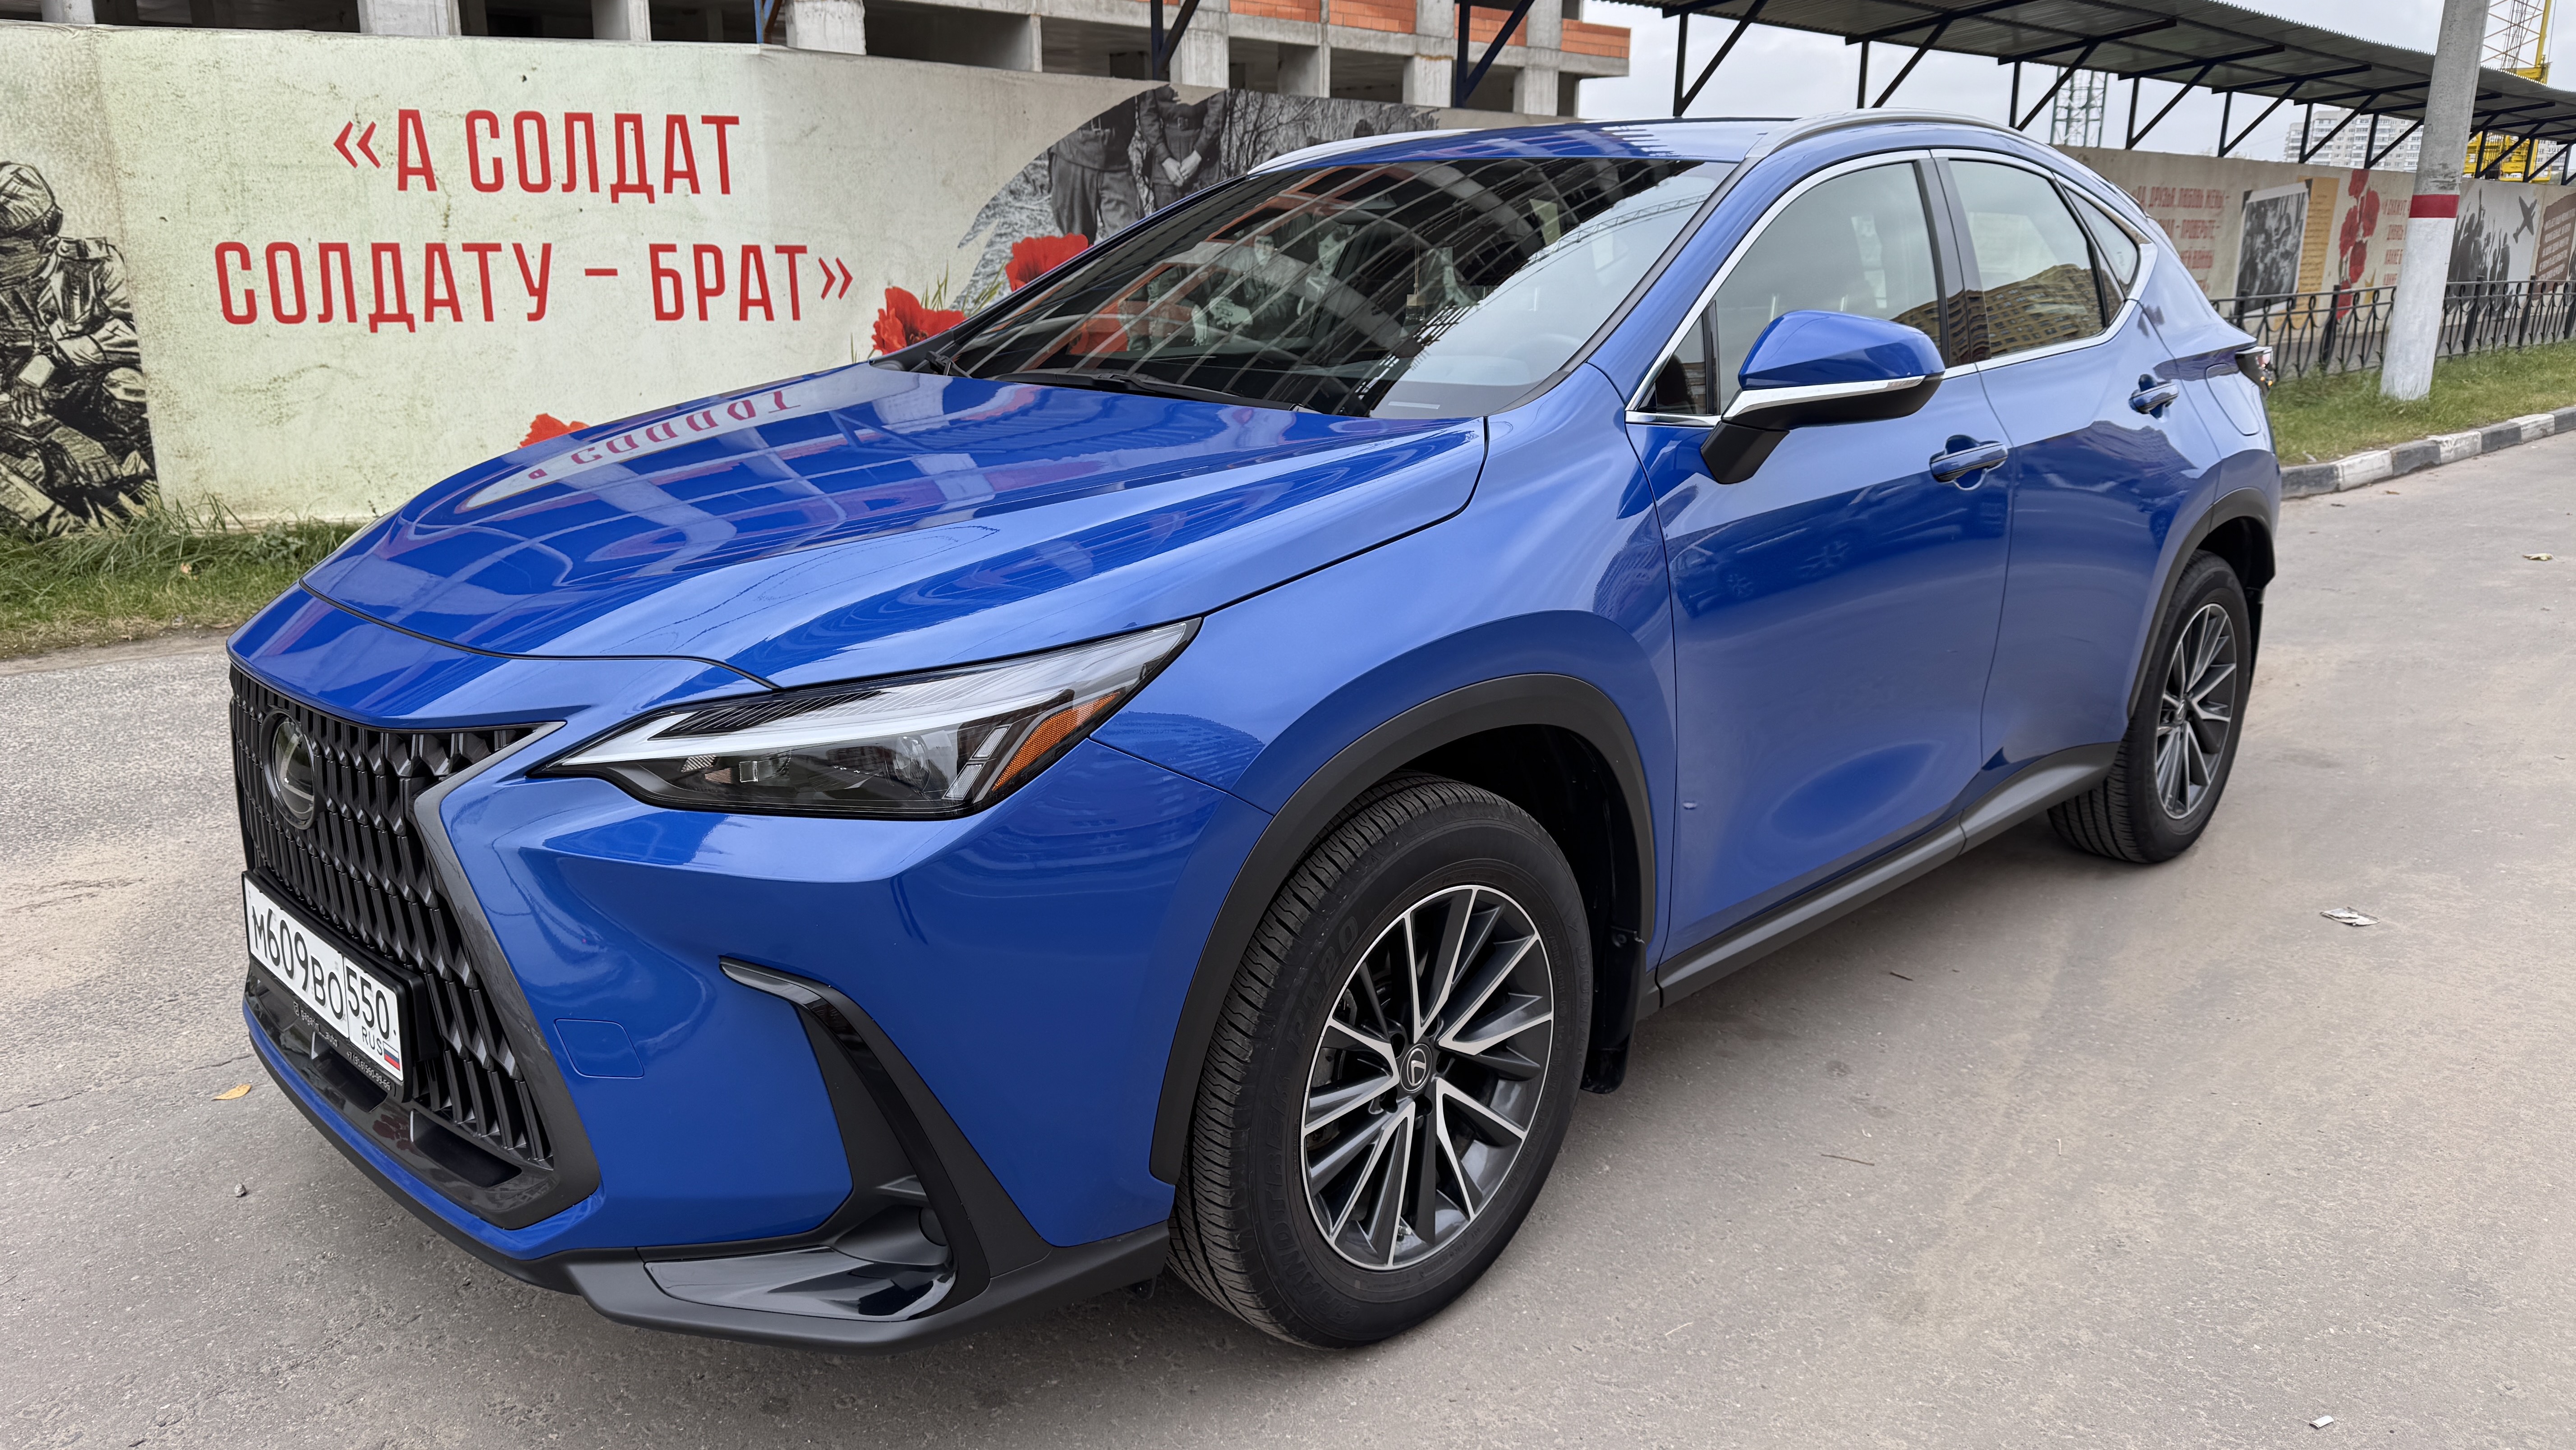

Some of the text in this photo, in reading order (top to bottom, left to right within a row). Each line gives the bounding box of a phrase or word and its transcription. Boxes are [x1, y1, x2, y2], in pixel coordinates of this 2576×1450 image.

[334, 109, 740, 203] «А СОЛДАТ
[215, 242, 552, 332] СОЛДАТУ
[649, 244, 853, 321] БРАТ»
[252, 905, 390, 1040] М609ВО 550
[362, 1026, 383, 1055] RUS
